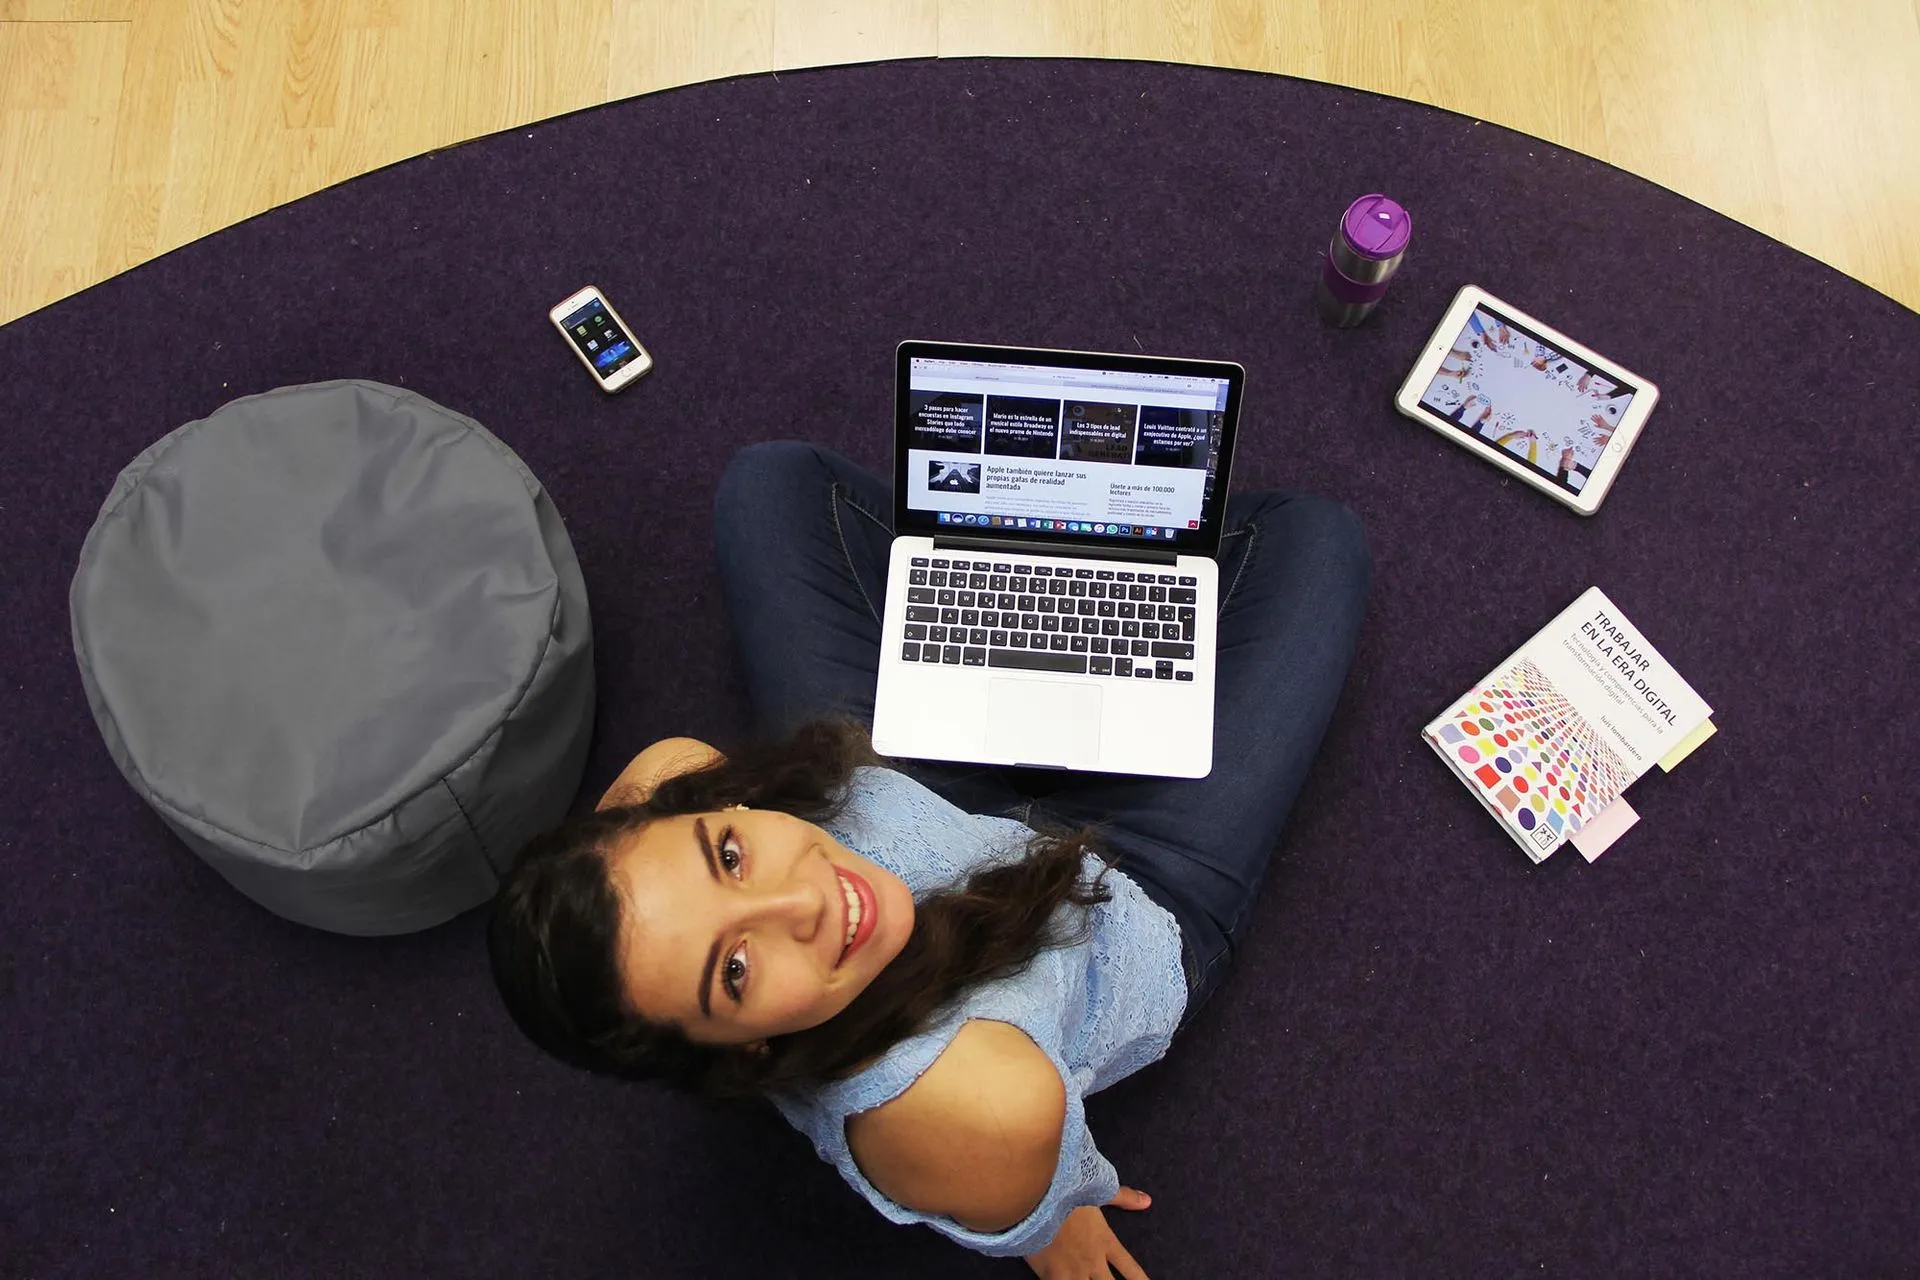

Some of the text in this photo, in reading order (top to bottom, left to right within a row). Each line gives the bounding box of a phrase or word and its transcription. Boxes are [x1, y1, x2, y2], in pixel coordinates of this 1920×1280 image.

[1024, 422, 1046, 430] Broadway
[1069, 430, 1104, 438] indispensables
[1006, 467, 1032, 476] también
[1056, 470, 1074, 478] lanzar
[1594, 611, 1650, 672] TRABAJAR
[1562, 639, 1624, 706] transformación digital
[1580, 622, 1678, 726] EN LA ERA DIGITAL
[1604, 670, 1644, 714] competencias
[1642, 712, 1657, 728] para
[1656, 722, 1664, 735] la
[1600, 715, 1642, 760] luis lombardero
